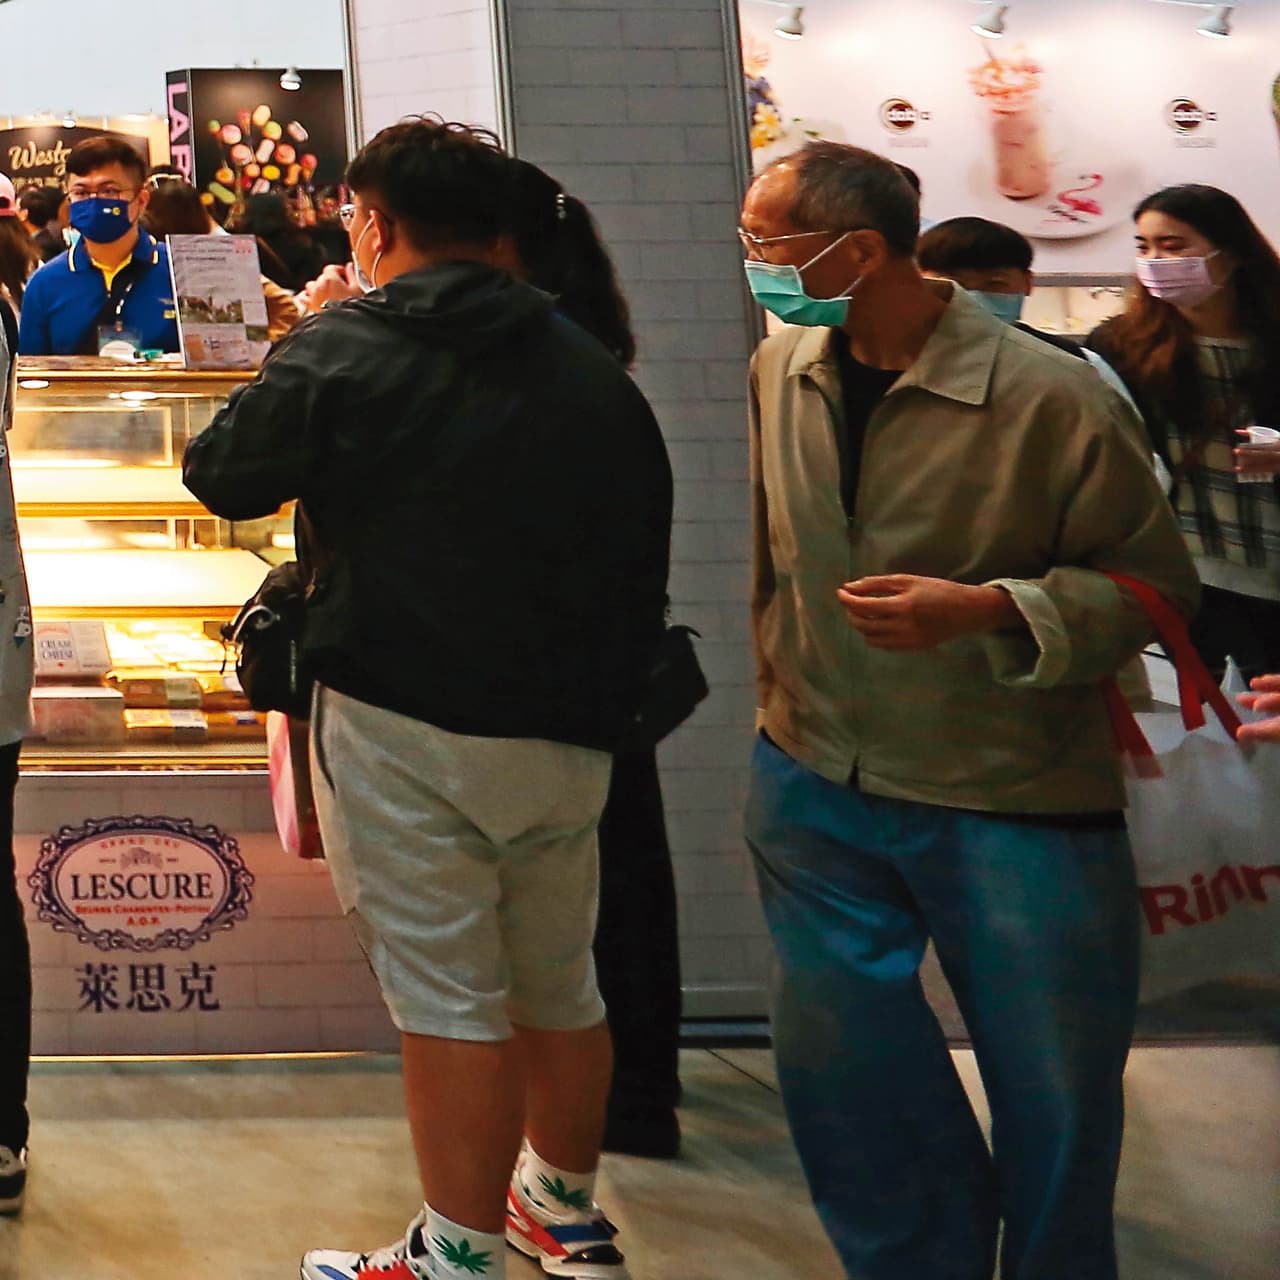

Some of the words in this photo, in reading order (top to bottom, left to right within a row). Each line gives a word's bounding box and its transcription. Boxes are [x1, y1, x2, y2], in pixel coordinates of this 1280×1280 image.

[70, 872, 214, 901] LESCURE
[75, 962, 221, 1014] 萊思克
